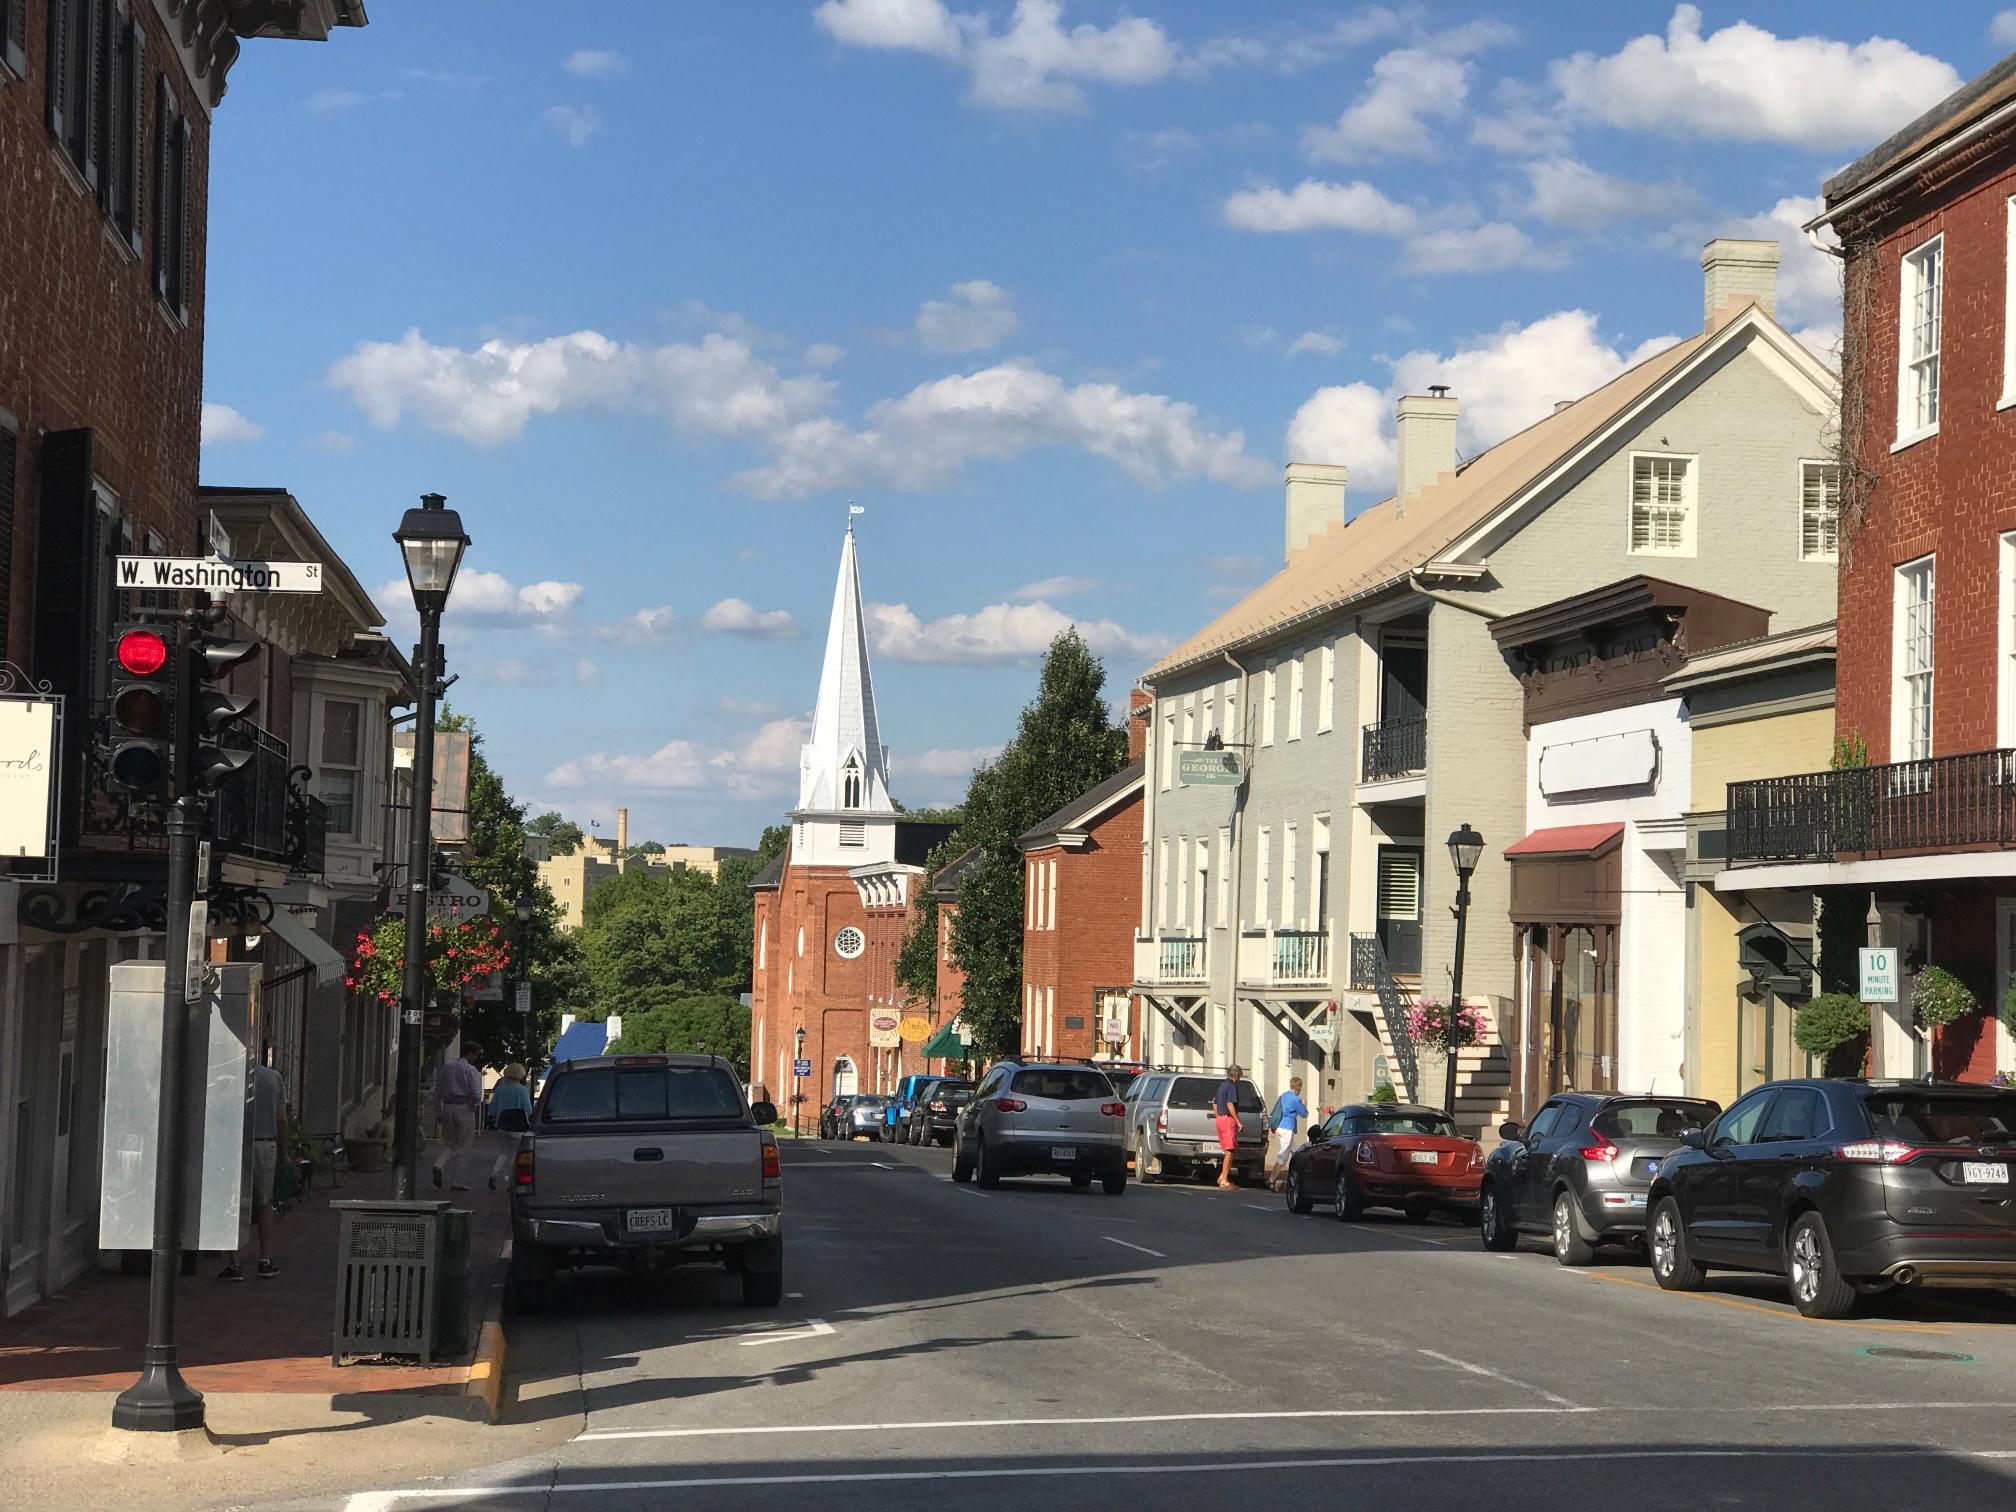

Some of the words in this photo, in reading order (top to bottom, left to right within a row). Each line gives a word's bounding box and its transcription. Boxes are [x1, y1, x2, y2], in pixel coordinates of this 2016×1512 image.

[121, 561, 144, 584] W.
[153, 561, 280, 590] Washington
[305, 565, 318, 578] St
[1870, 954, 1887, 971] 10
[1867, 975, 1890, 984] MINUTE
[1864, 986, 1894, 996] PARKING
[560, 1194, 607, 1202] TUNDRA
